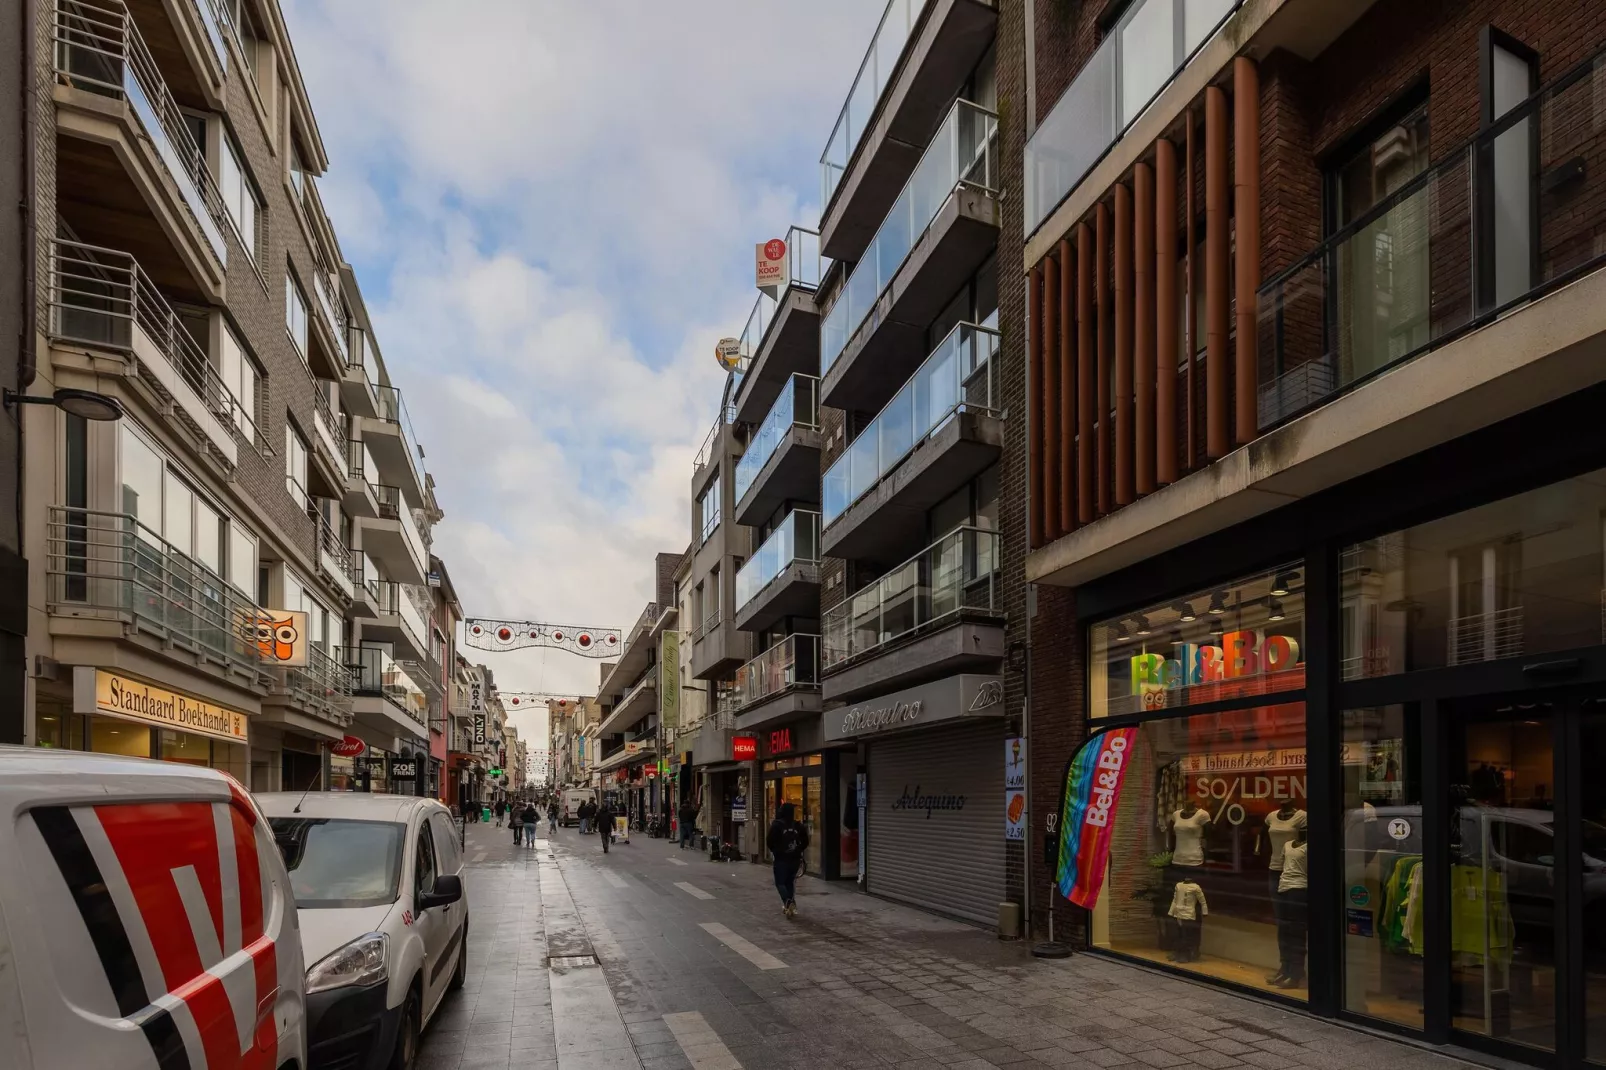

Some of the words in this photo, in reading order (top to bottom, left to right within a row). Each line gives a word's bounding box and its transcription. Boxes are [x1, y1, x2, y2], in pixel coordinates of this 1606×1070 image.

[1131, 630, 1299, 696] Bel&Bo
[110, 677, 175, 721] Standaard
[178, 697, 231, 734] Boekhandel
[471, 683, 480, 711] MAXIM
[476, 716, 484, 743] ONLY
[841, 700, 922, 733] Arlequino
[393, 761, 415, 770] ZOË
[1086, 737, 1127, 827] Bel&Bo
[892, 784, 968, 820] Arlequino
[1046, 813, 1058, 833] 92
